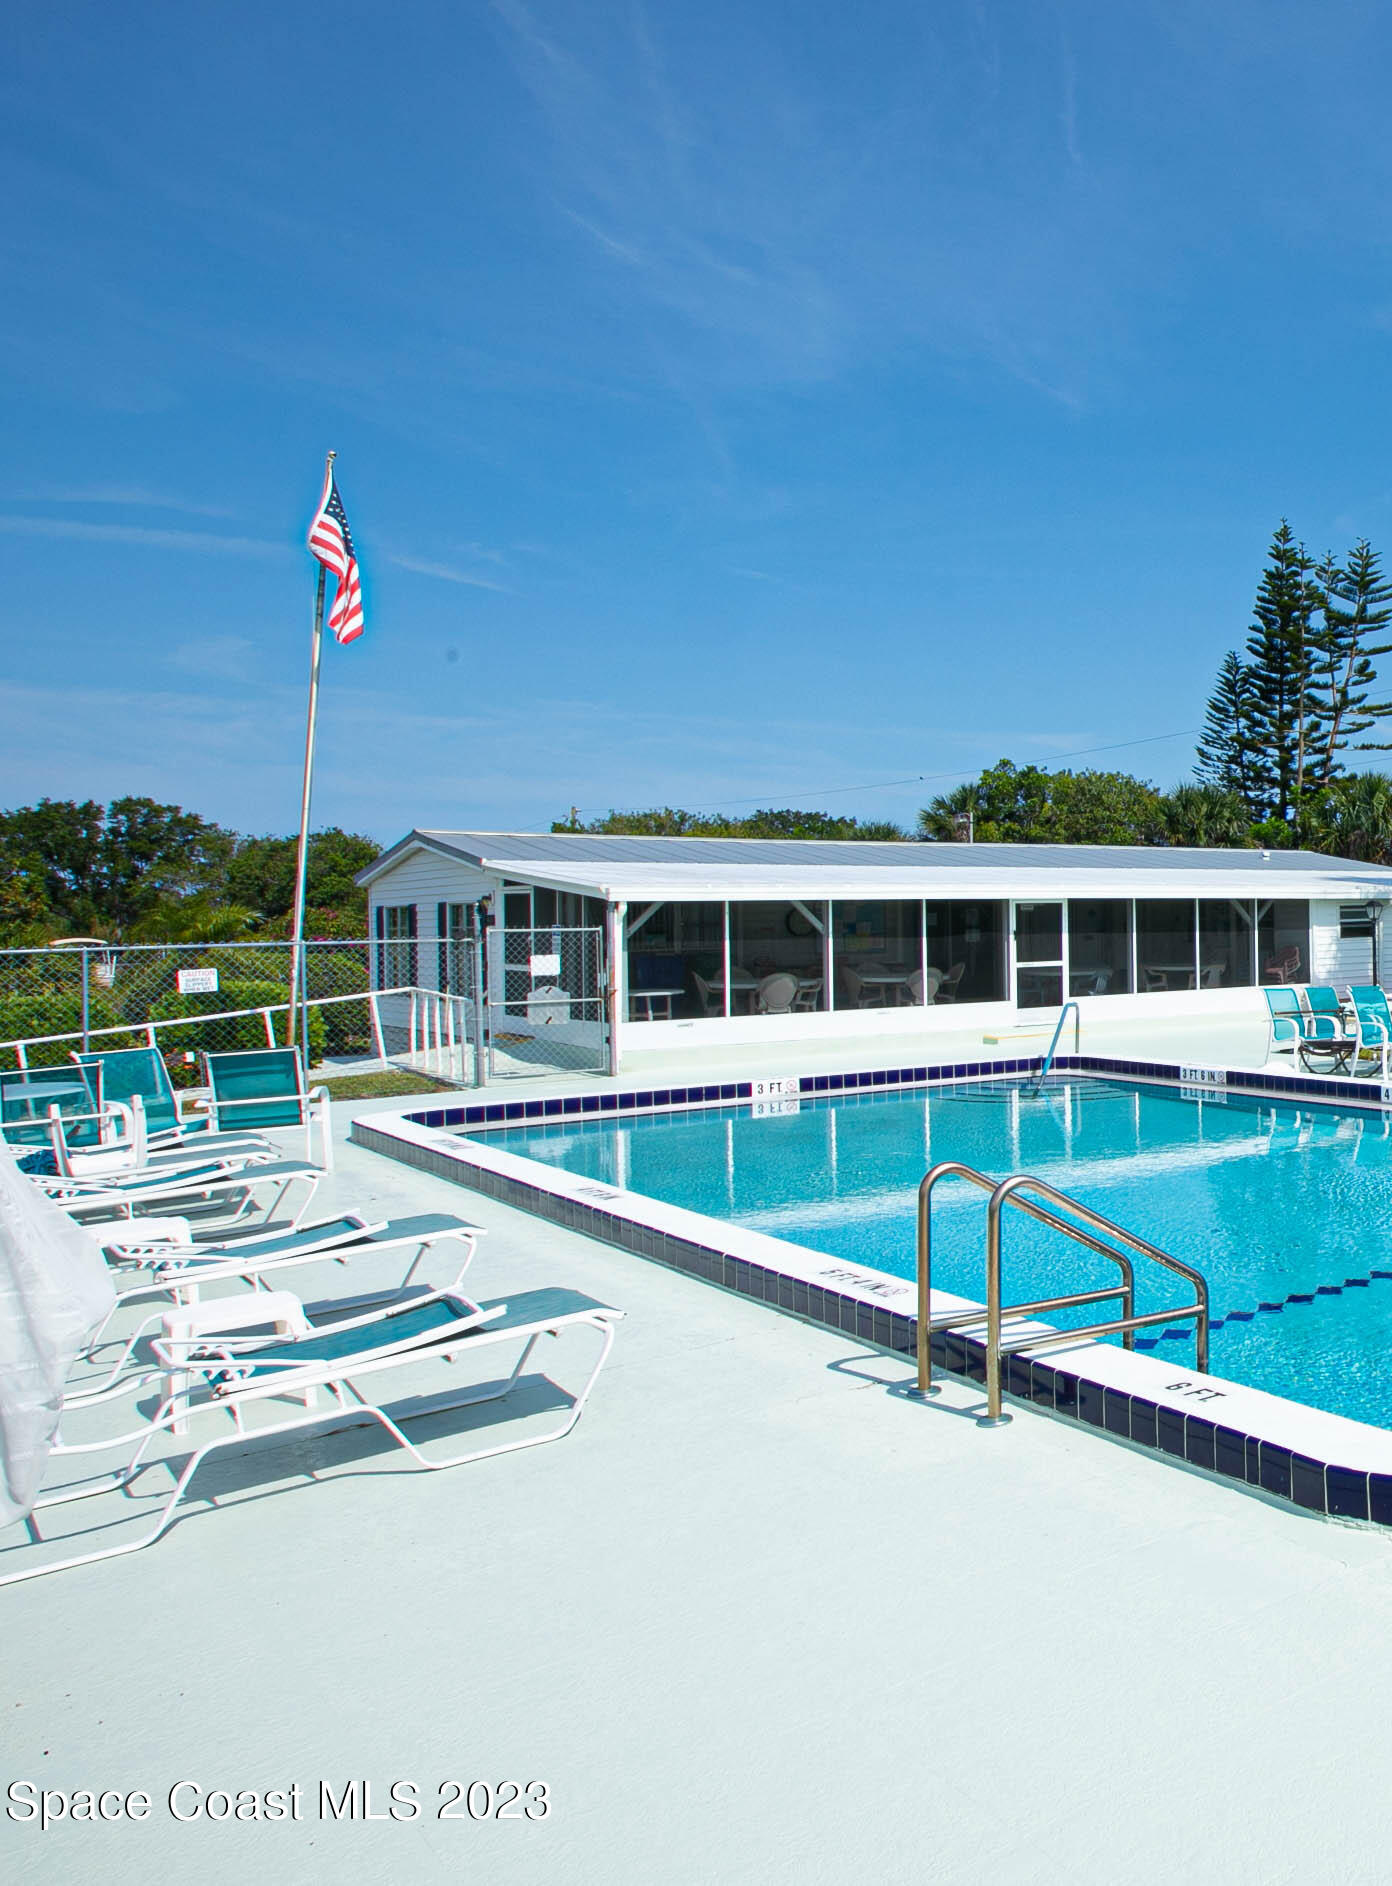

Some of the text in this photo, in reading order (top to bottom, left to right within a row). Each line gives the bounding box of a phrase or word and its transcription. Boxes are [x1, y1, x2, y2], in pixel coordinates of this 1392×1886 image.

[1182, 1068, 1187, 1079] 3
[1200, 1070, 1205, 1081] 6
[757, 1083, 764, 1094] 3
[1384, 1088, 1390, 1100] 4
[1165, 1382, 1193, 1391] 6
